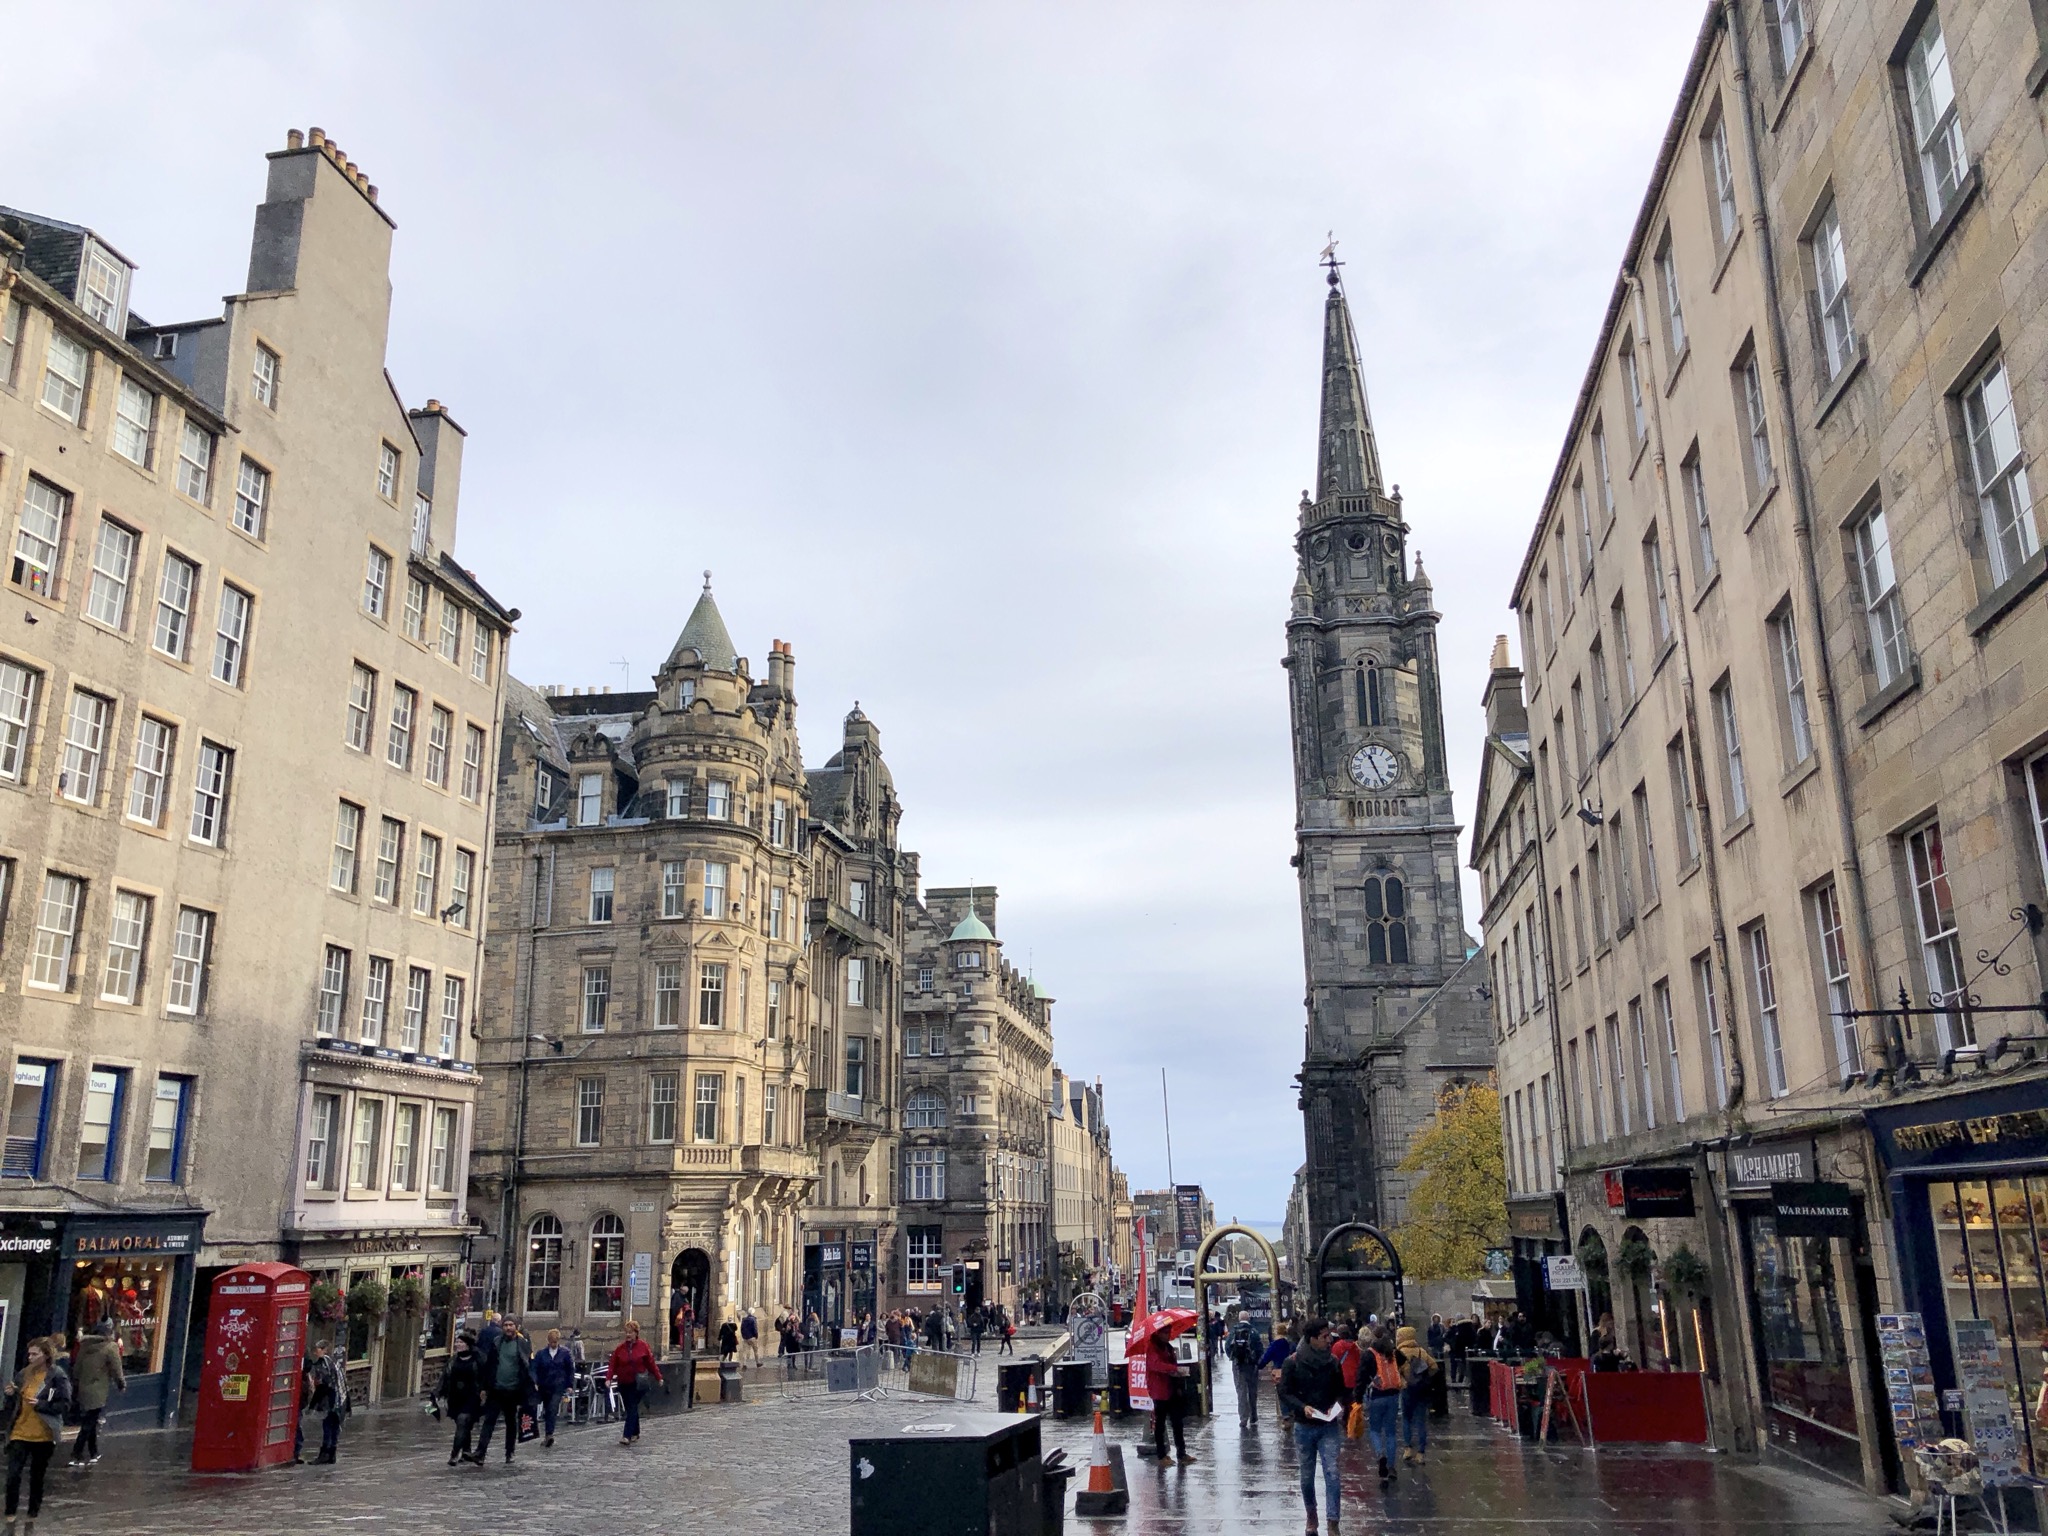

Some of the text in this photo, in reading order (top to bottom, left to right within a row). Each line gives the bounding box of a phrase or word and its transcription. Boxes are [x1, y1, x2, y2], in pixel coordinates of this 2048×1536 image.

[15, 1073, 41, 1083] ighland
[90, 1079, 107, 1089] Tours
[1734, 1153, 1802, 1182] WARHAMMER
[1777, 1206, 1849, 1216] WARHAMMER
[0, 1236, 52, 1253] xchange
[78, 1236, 162, 1252] BALMORAL
[120, 1316, 160, 1327] BALMORAL
